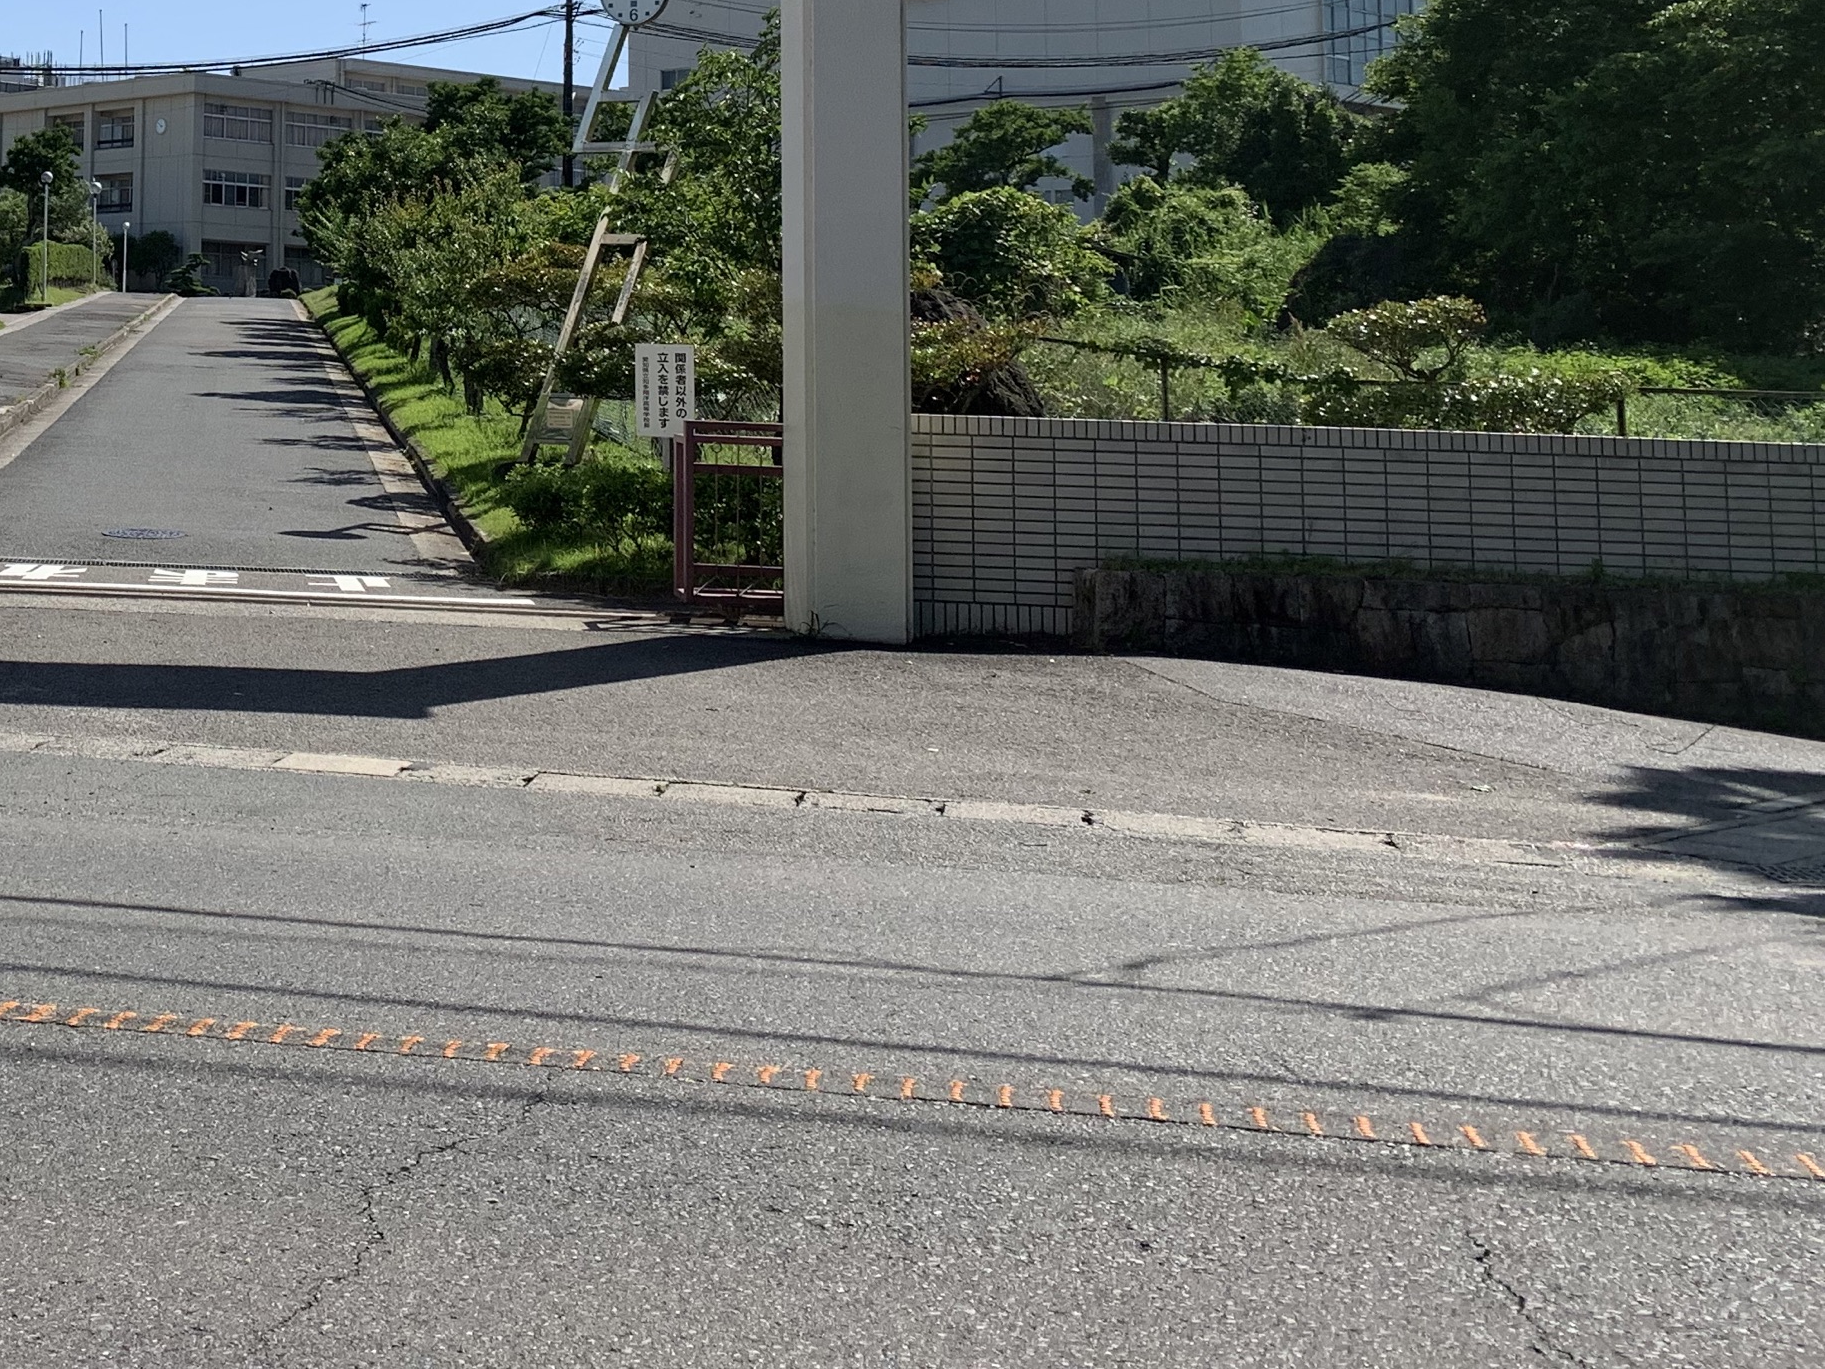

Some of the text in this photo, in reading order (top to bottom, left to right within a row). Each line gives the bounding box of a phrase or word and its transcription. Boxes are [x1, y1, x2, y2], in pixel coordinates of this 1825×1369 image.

[630, 8, 638, 21] 6
[657, 352, 670, 429] 立入を禁じます
[675, 353, 687, 418] 関係者以外の
